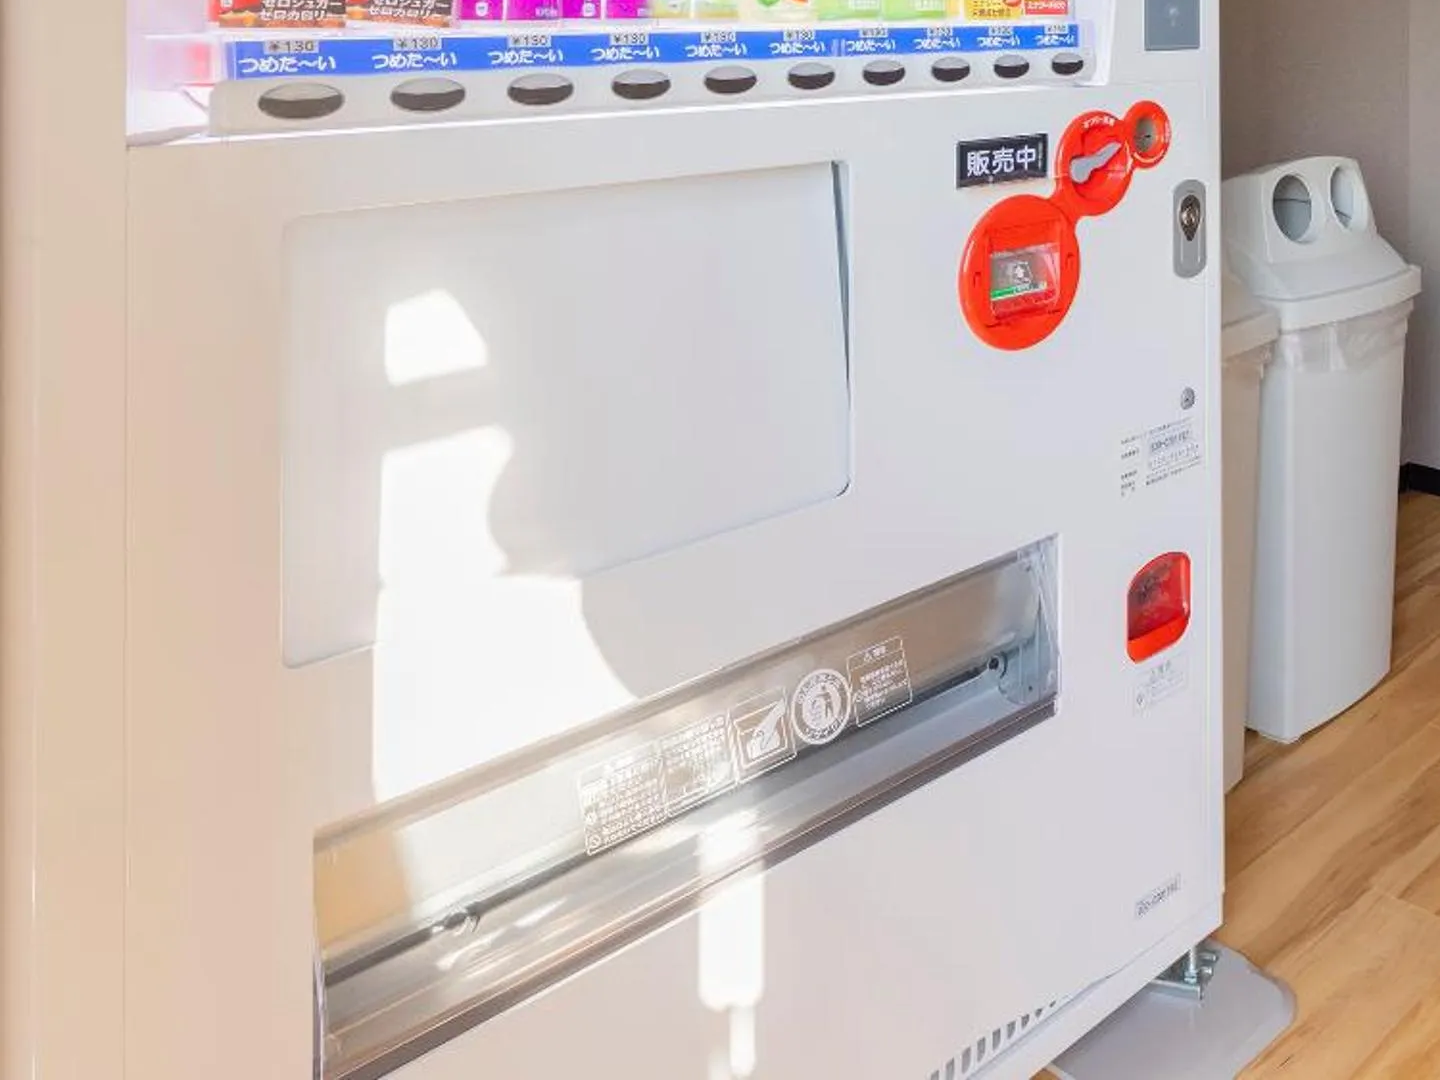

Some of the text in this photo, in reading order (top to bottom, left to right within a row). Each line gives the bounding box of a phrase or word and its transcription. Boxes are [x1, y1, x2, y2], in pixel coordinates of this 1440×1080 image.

[268, 39, 315, 53] ¥130
[966, 144, 1037, 177] 販売中
